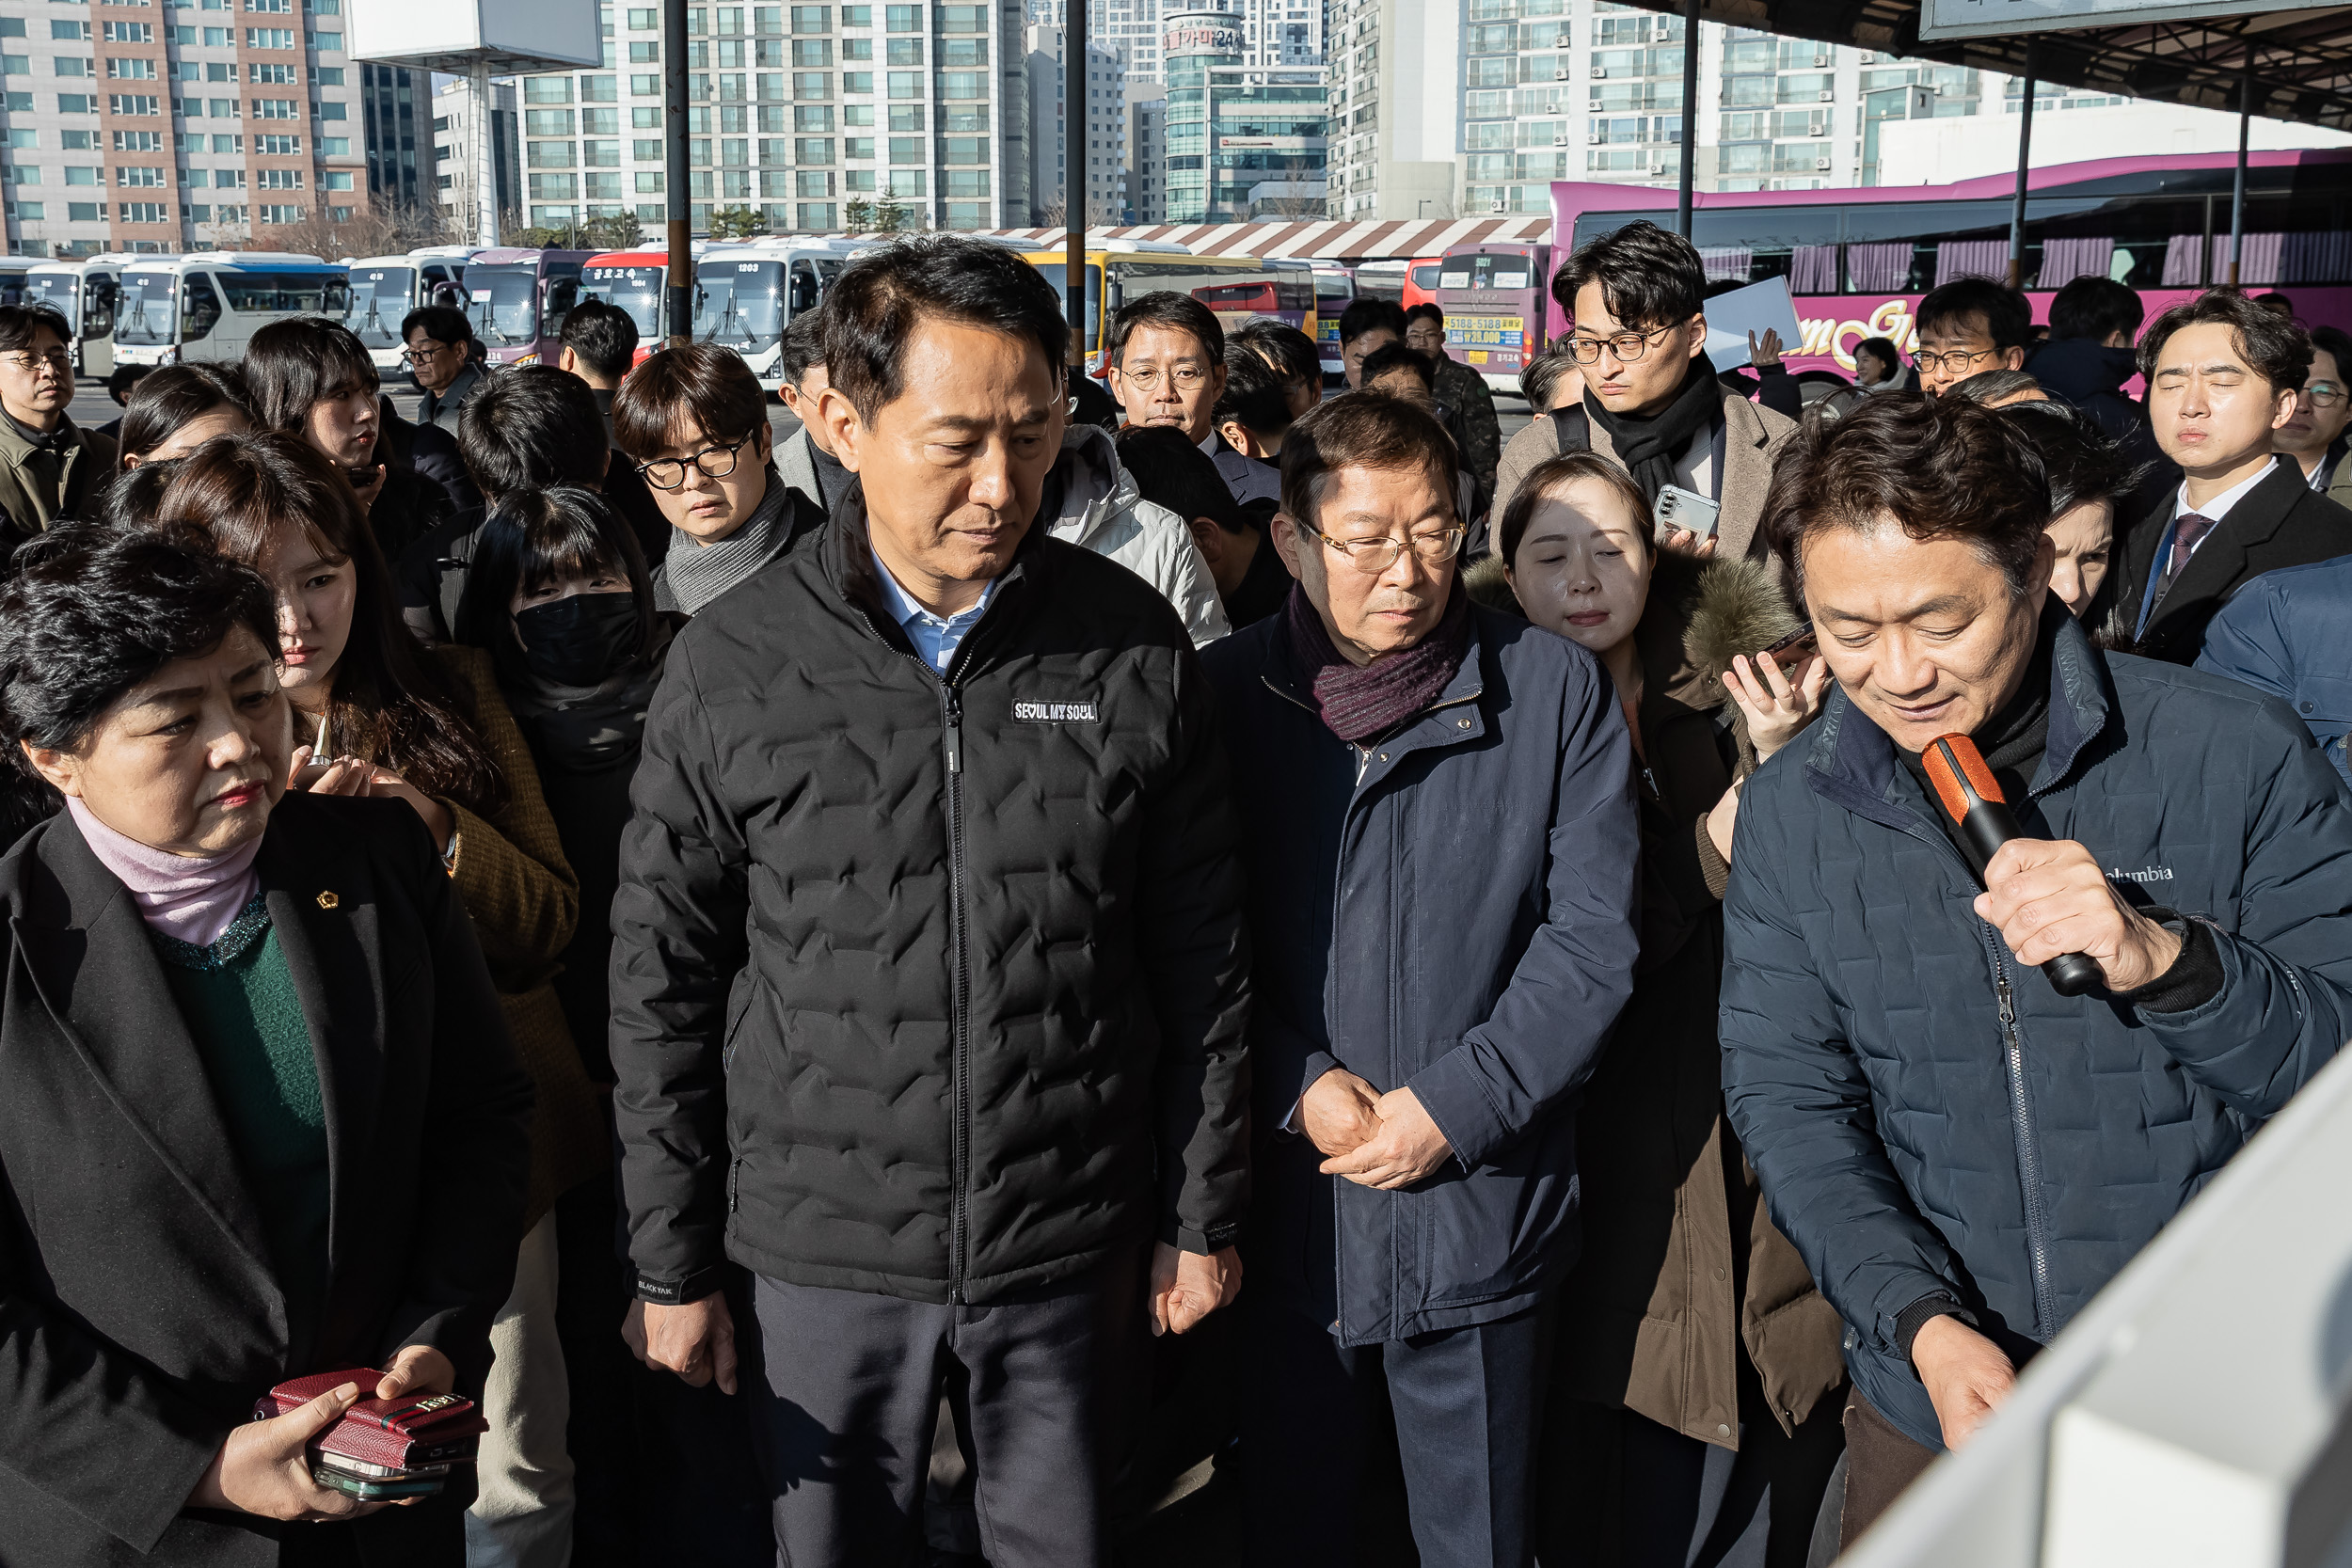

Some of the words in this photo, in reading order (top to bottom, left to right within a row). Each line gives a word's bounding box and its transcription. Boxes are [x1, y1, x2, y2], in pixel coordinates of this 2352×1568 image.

[738, 263, 759, 272] 1203
[594, 268, 637, 280] 금호고속
[1450, 318, 1501, 329] 5188-5188
[2105, 864, 2174, 883] olumbia
